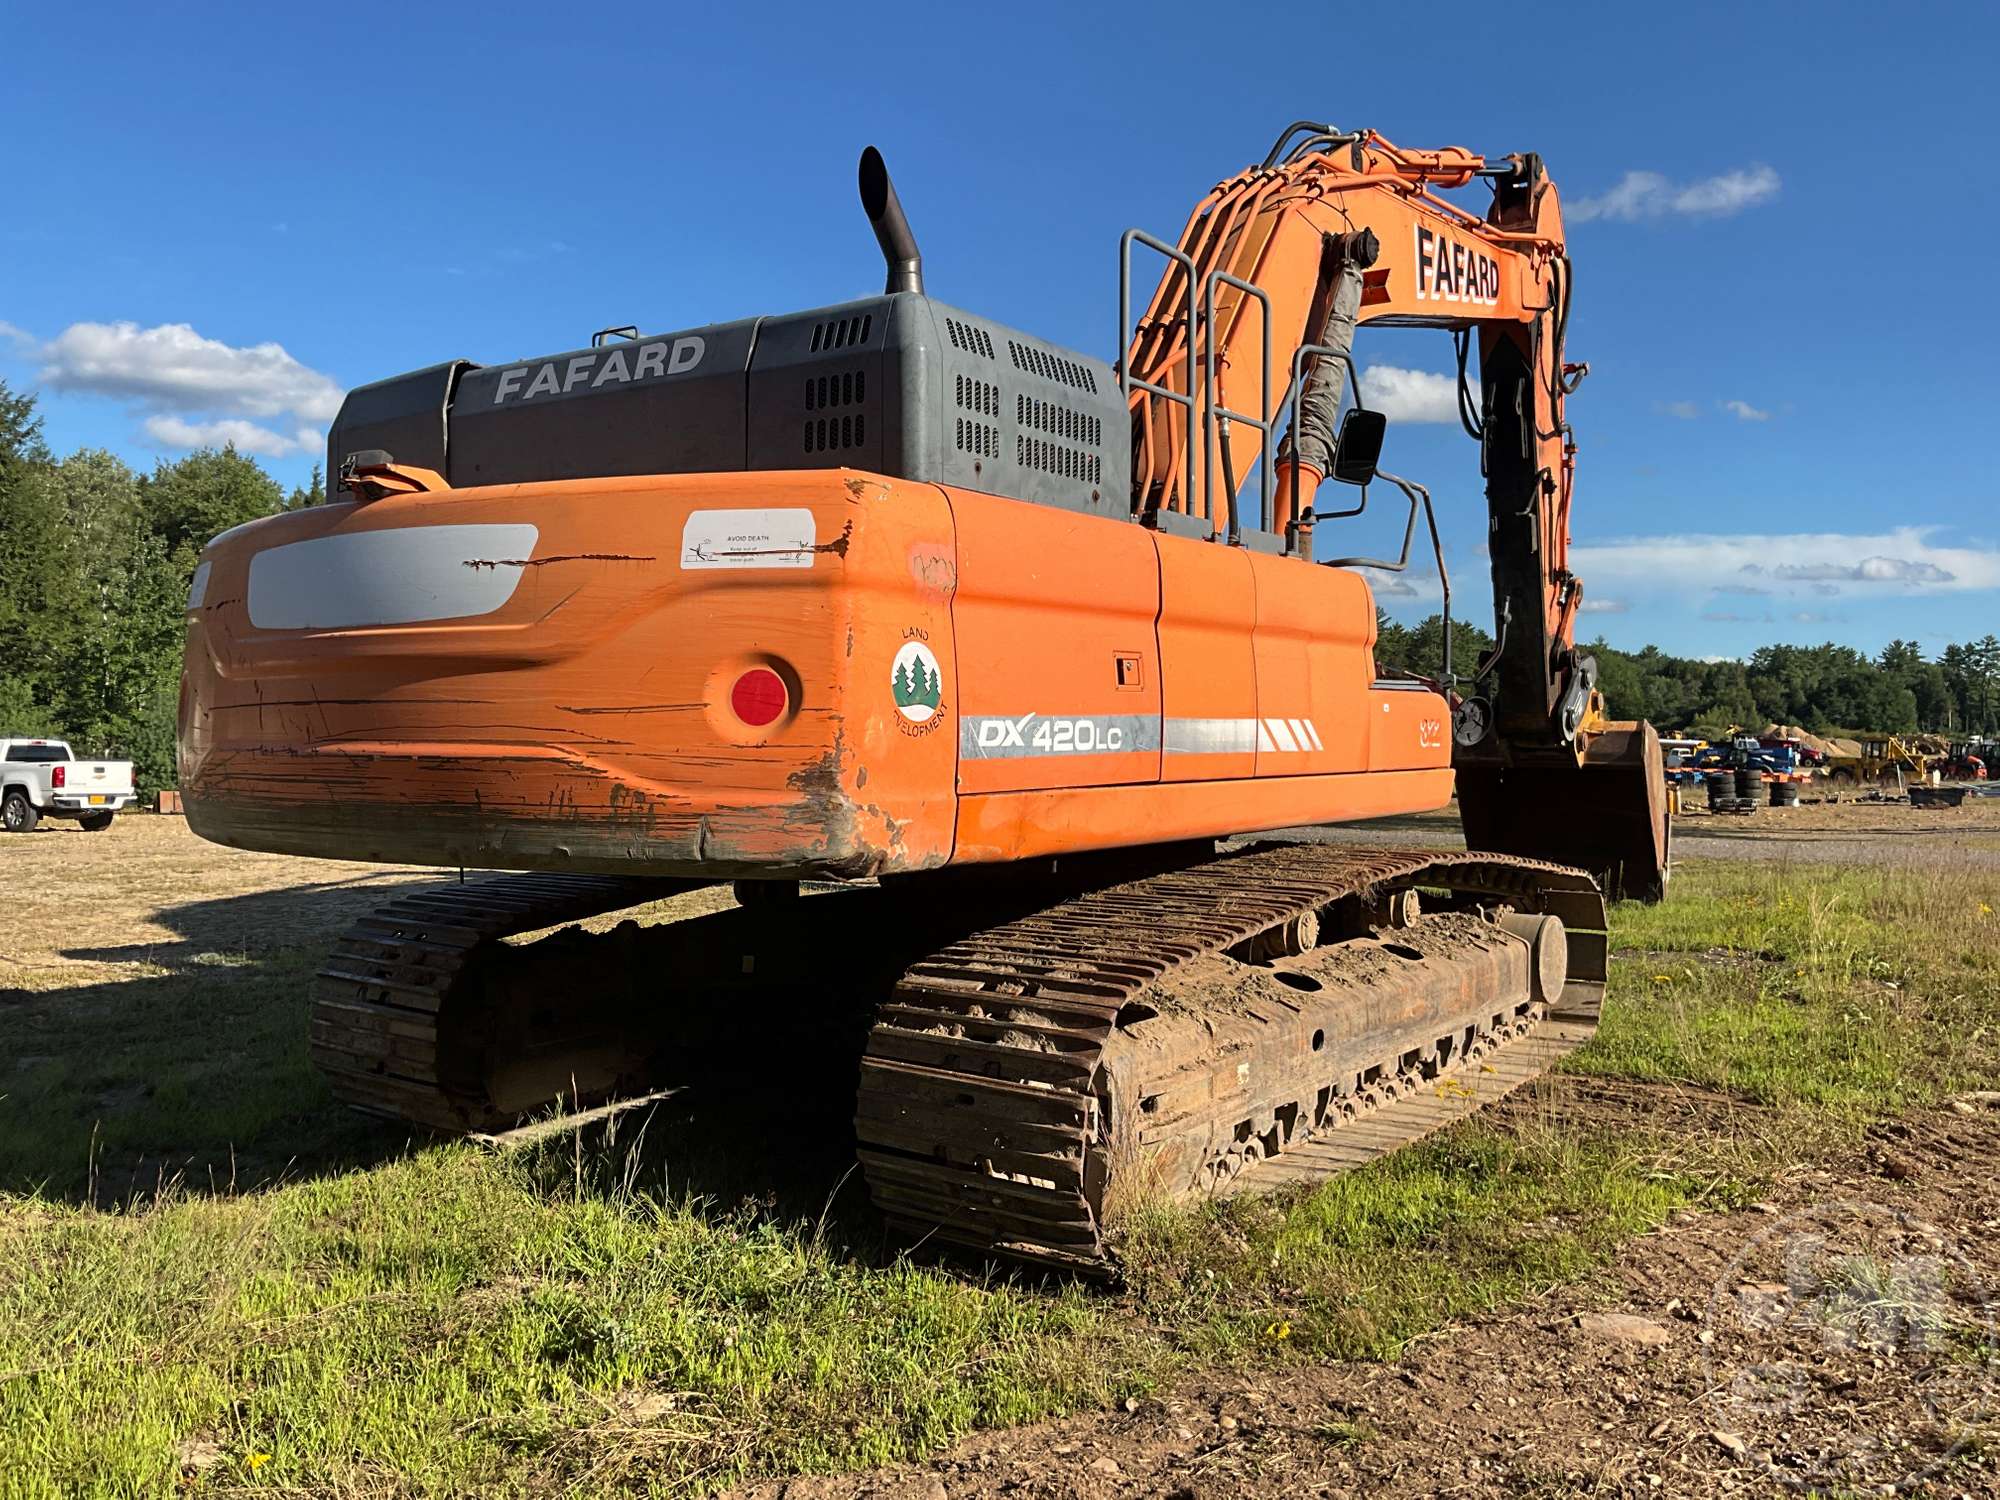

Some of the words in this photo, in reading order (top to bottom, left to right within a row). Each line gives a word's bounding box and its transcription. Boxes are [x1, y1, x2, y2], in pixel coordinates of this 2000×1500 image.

[1414, 222, 1499, 305] FAFARD
[494, 336, 705, 404] FAFARD
[901, 626, 928, 641] LAND
